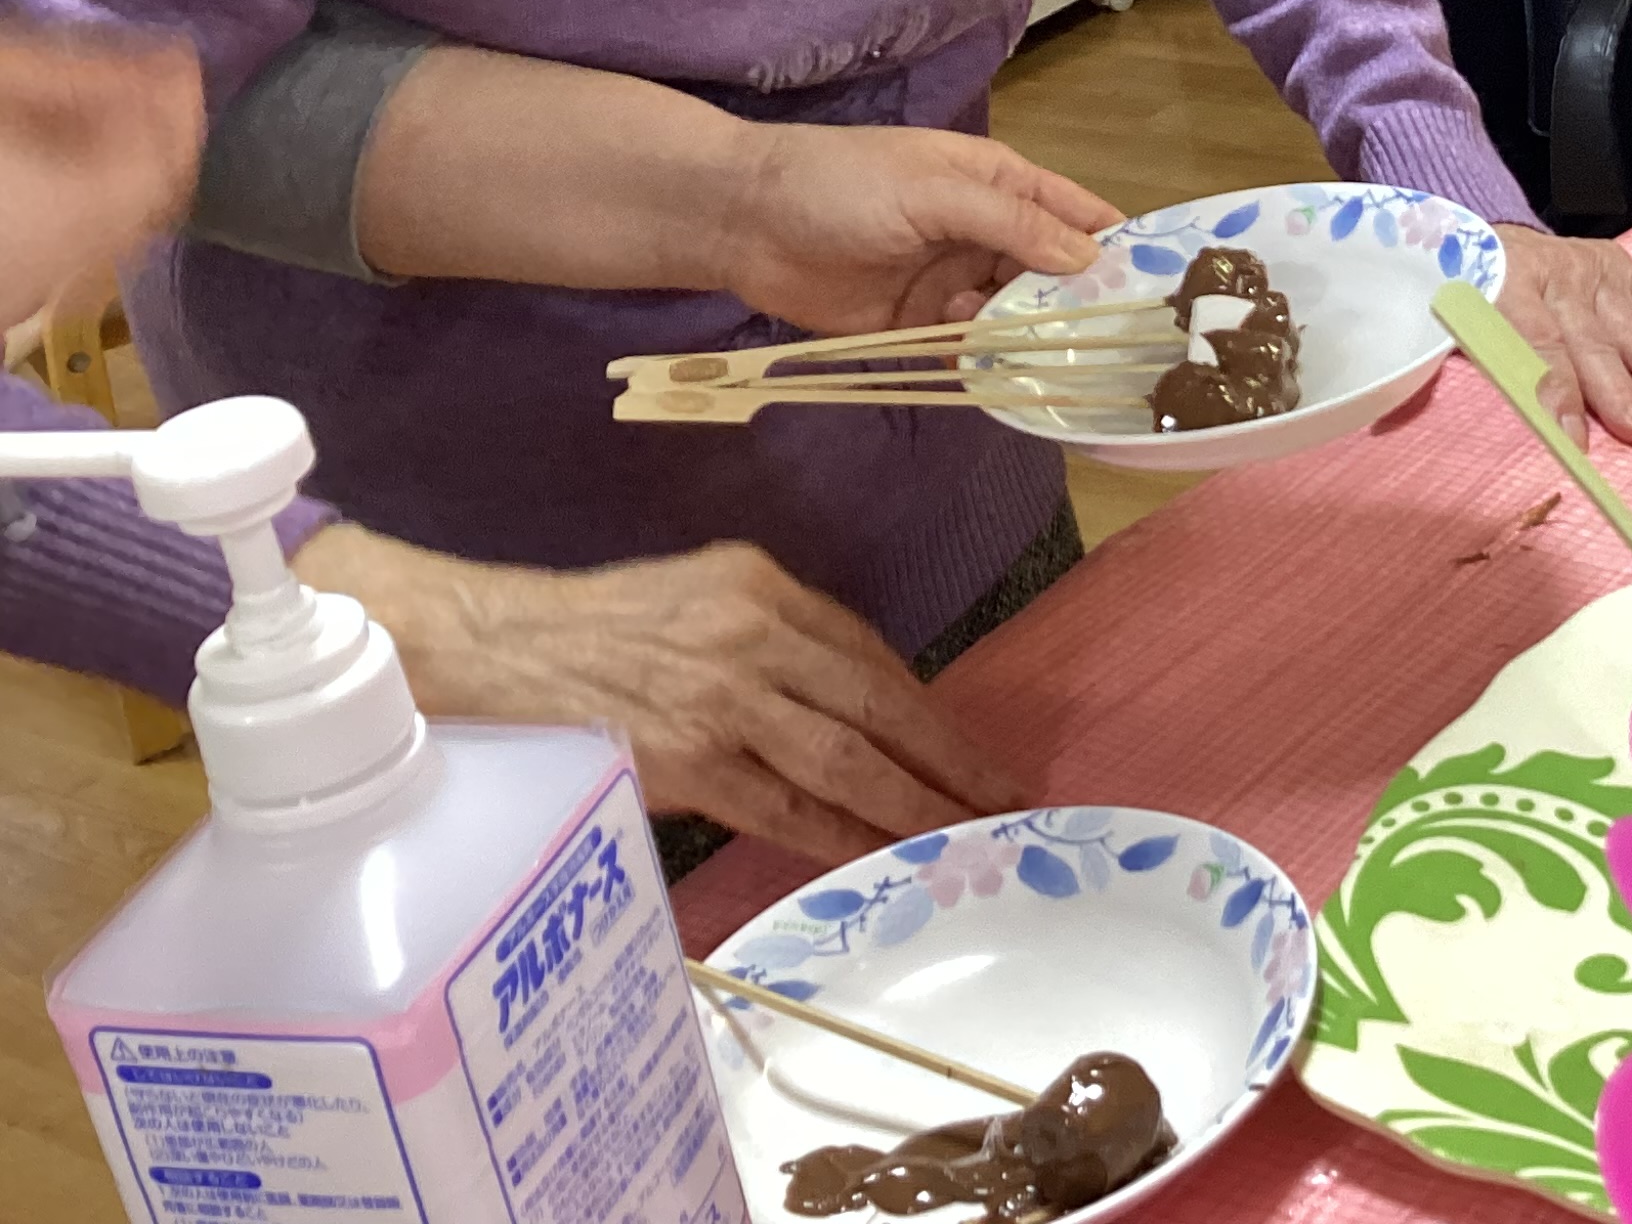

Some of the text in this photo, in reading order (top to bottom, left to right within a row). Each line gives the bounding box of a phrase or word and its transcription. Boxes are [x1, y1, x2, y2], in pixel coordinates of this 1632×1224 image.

[493, 838, 626, 1034] アルボナース
